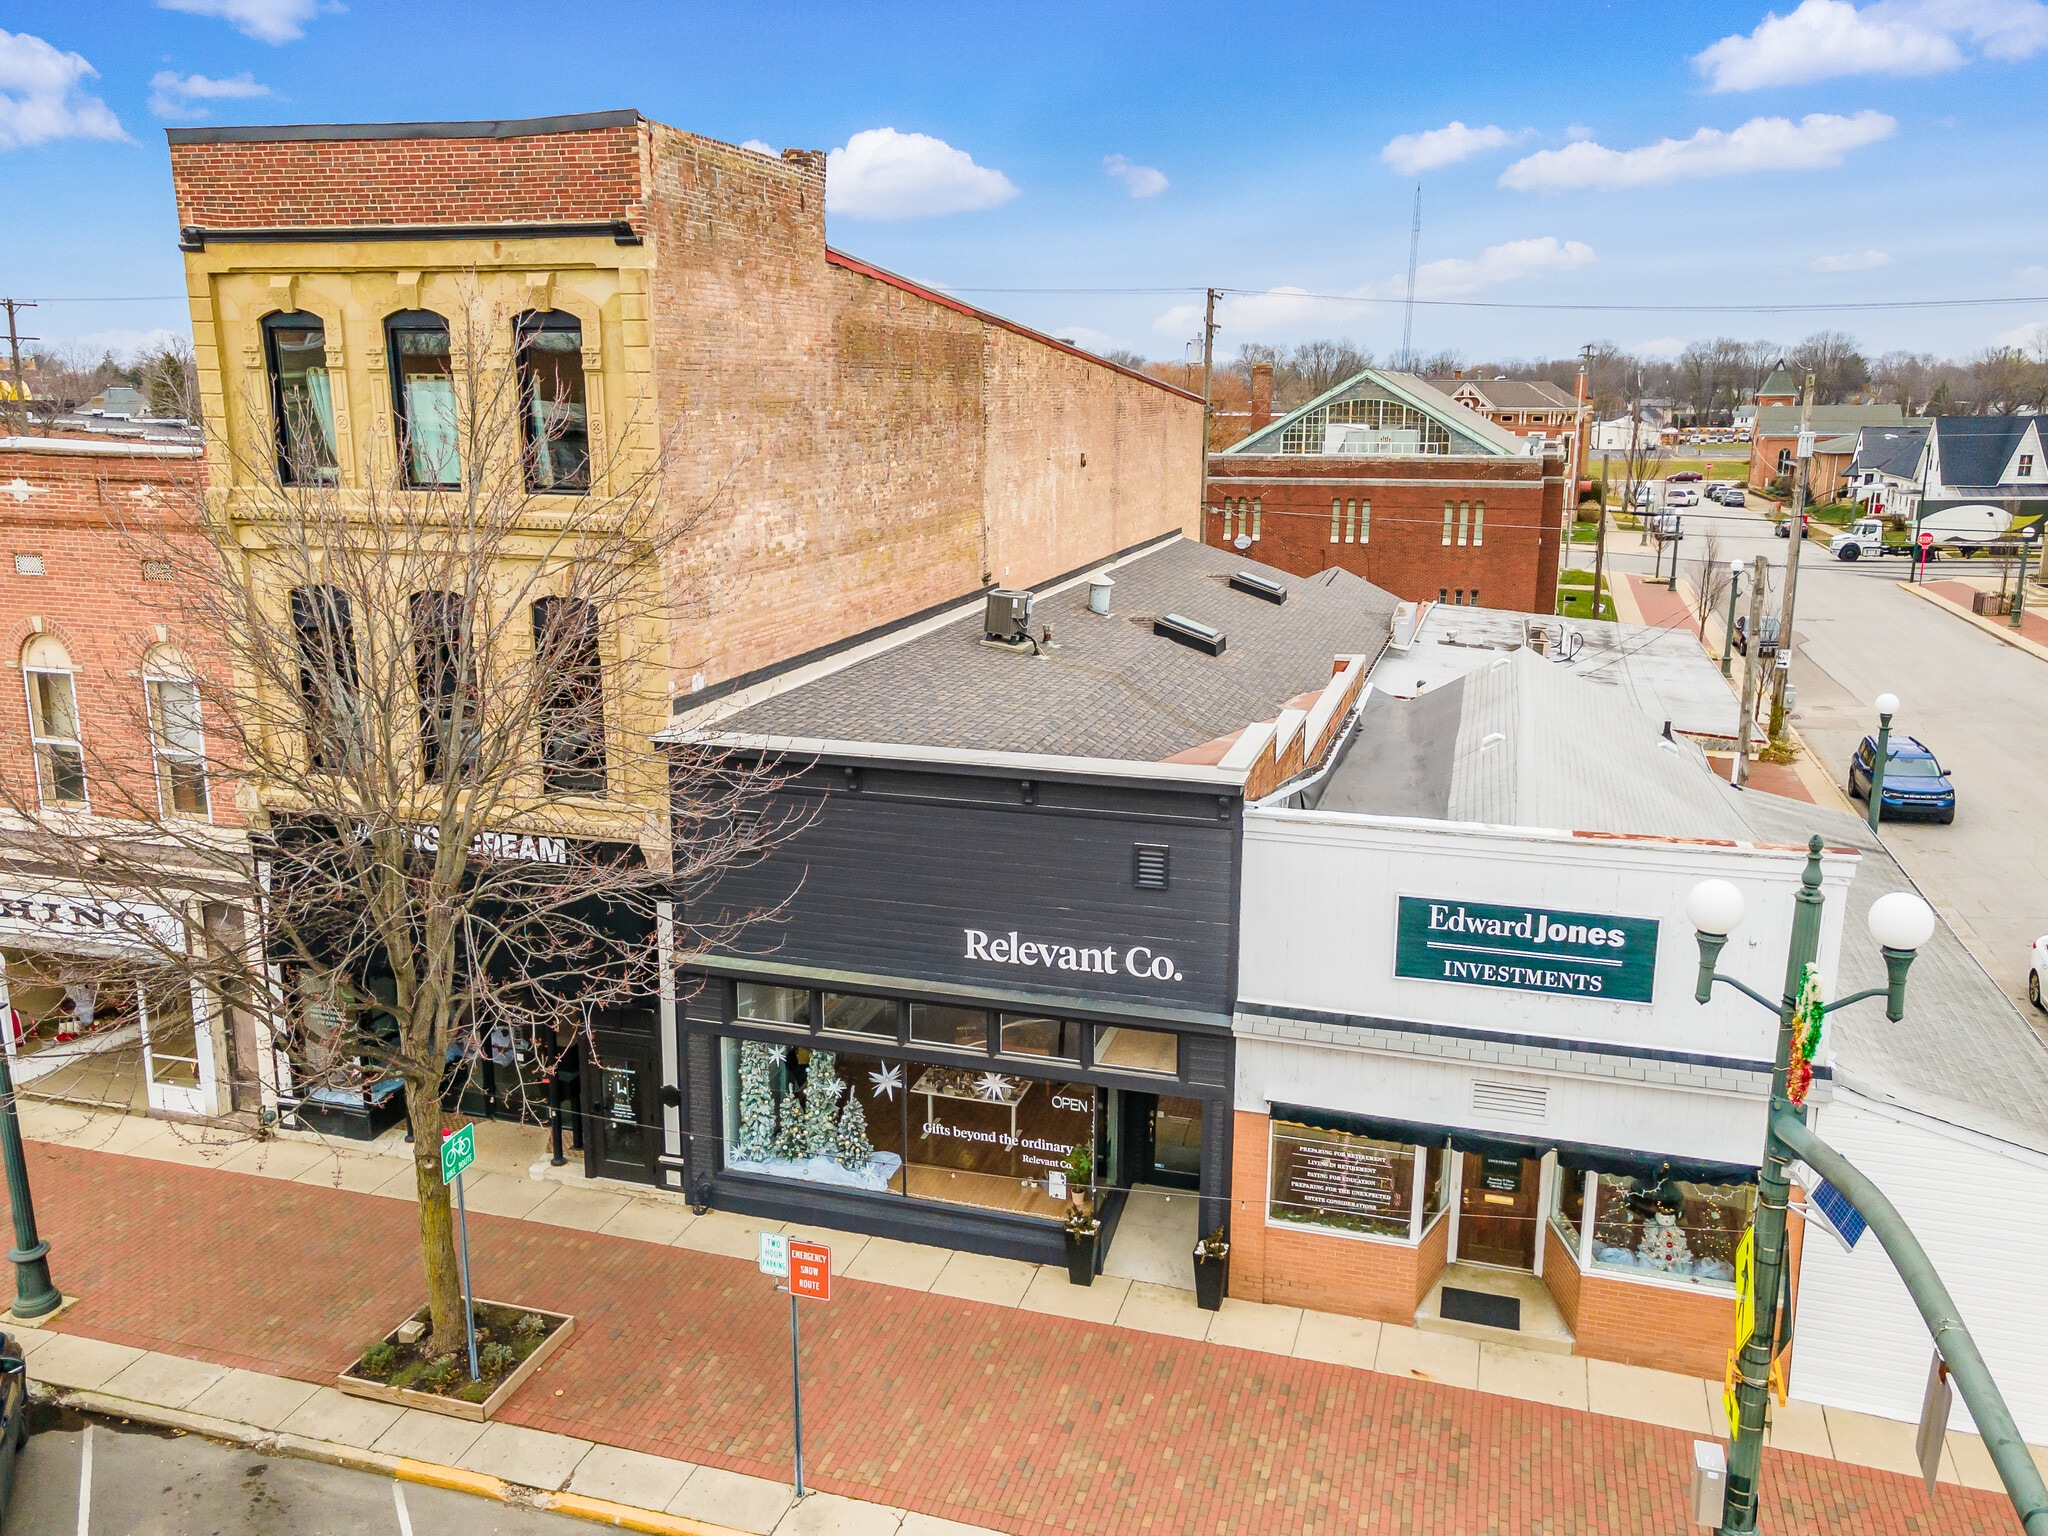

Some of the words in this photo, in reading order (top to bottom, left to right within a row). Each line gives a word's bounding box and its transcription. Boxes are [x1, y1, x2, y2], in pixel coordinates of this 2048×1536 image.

[413, 825, 441, 851] IC
[964, 929, 1118, 975] Relevant
[1125, 947, 1183, 982] Co.
[1443, 960, 1602, 992] INVESTMENTS
[1052, 1096, 1088, 1113] OPEN
[923, 1123, 950, 1136] Gifts
[953, 1126, 996, 1142] beyond
[999, 1134, 1018, 1146] the
[1021, 1138, 1074, 1156] ordinary
[1022, 1154, 1059, 1168] Relevant
[1059, 1160, 1074, 1170] Co.
[1299, 1146, 1333, 1156] PREPARING
[1334, 1150, 1346, 1158] FOR
[1346, 1152, 1386, 1163] RETIREMENT
[1307, 1160, 1329, 1168] LIVING
[1337, 1163, 1377, 1174] RETIREMENT
[1307, 1171, 1328, 1179] PAYING
[1341, 1176, 1376, 1186] EDUCATION
[1291, 1181, 1324, 1191] PREPARING
[1338, 1187, 1350, 1195] THE
[1351, 1190, 1391, 1201] UNEXPECTED
[1304, 1195, 1326, 1203] ESTATE
[1326, 1197, 1377, 1210] CONSIDERATIONS
[768, 1239, 780, 1248] TWO
[765, 1249, 783, 1259] HOUR
[791, 1250, 827, 1263] EMERGENCY
[763, 1259, 785, 1270] PARKING
[801, 1265, 819, 1276] SNOW
[799, 1279, 820, 1290] ROUTE
